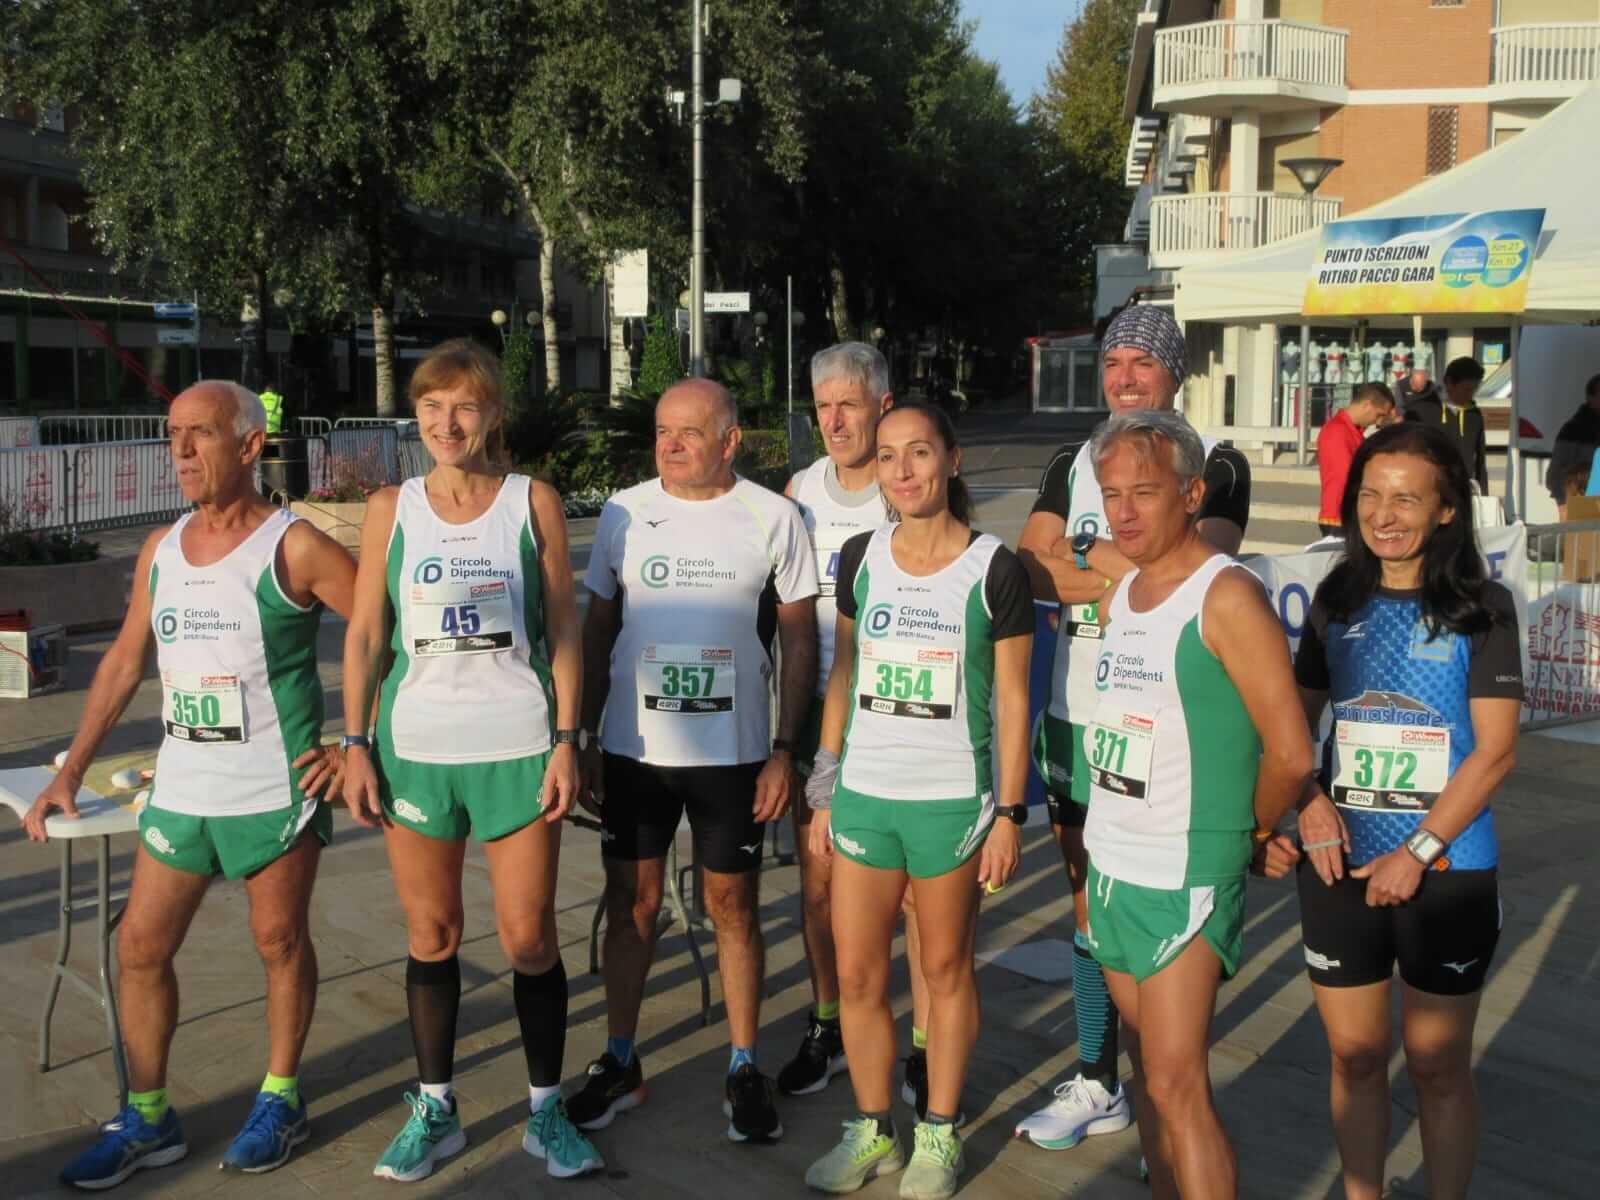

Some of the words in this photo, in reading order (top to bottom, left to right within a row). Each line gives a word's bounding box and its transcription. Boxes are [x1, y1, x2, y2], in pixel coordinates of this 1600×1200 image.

[1324, 247, 1363, 263] PUNTO
[1363, 244, 1430, 261] ISCRIZIONI
[1319, 268, 1358, 285] RITIRO
[1359, 267, 1399, 283] PACCO
[1401, 266, 1435, 282] GARA
[450, 557, 493, 567] Circolo
[676, 557, 715, 567] Circolo
[450, 567, 514, 580] Dipendenti
[676, 568, 737, 581] Dipendenti
[183, 608, 220, 619] Circolo
[441, 605, 481, 637] 45
[900, 605, 939, 619] Circolo
[183, 619, 241, 633] Dipendenti
[897, 616, 961, 635] Dipendenti
[1116, 654, 1144, 666] Circolo
[661, 665, 716, 698] 357
[876, 663, 934, 702] 354
[1113, 666, 1164, 683] Dipendenti
[171, 692, 221, 727] 350
[1092, 726, 1128, 774] 371
[1353, 749, 1418, 790] 372
